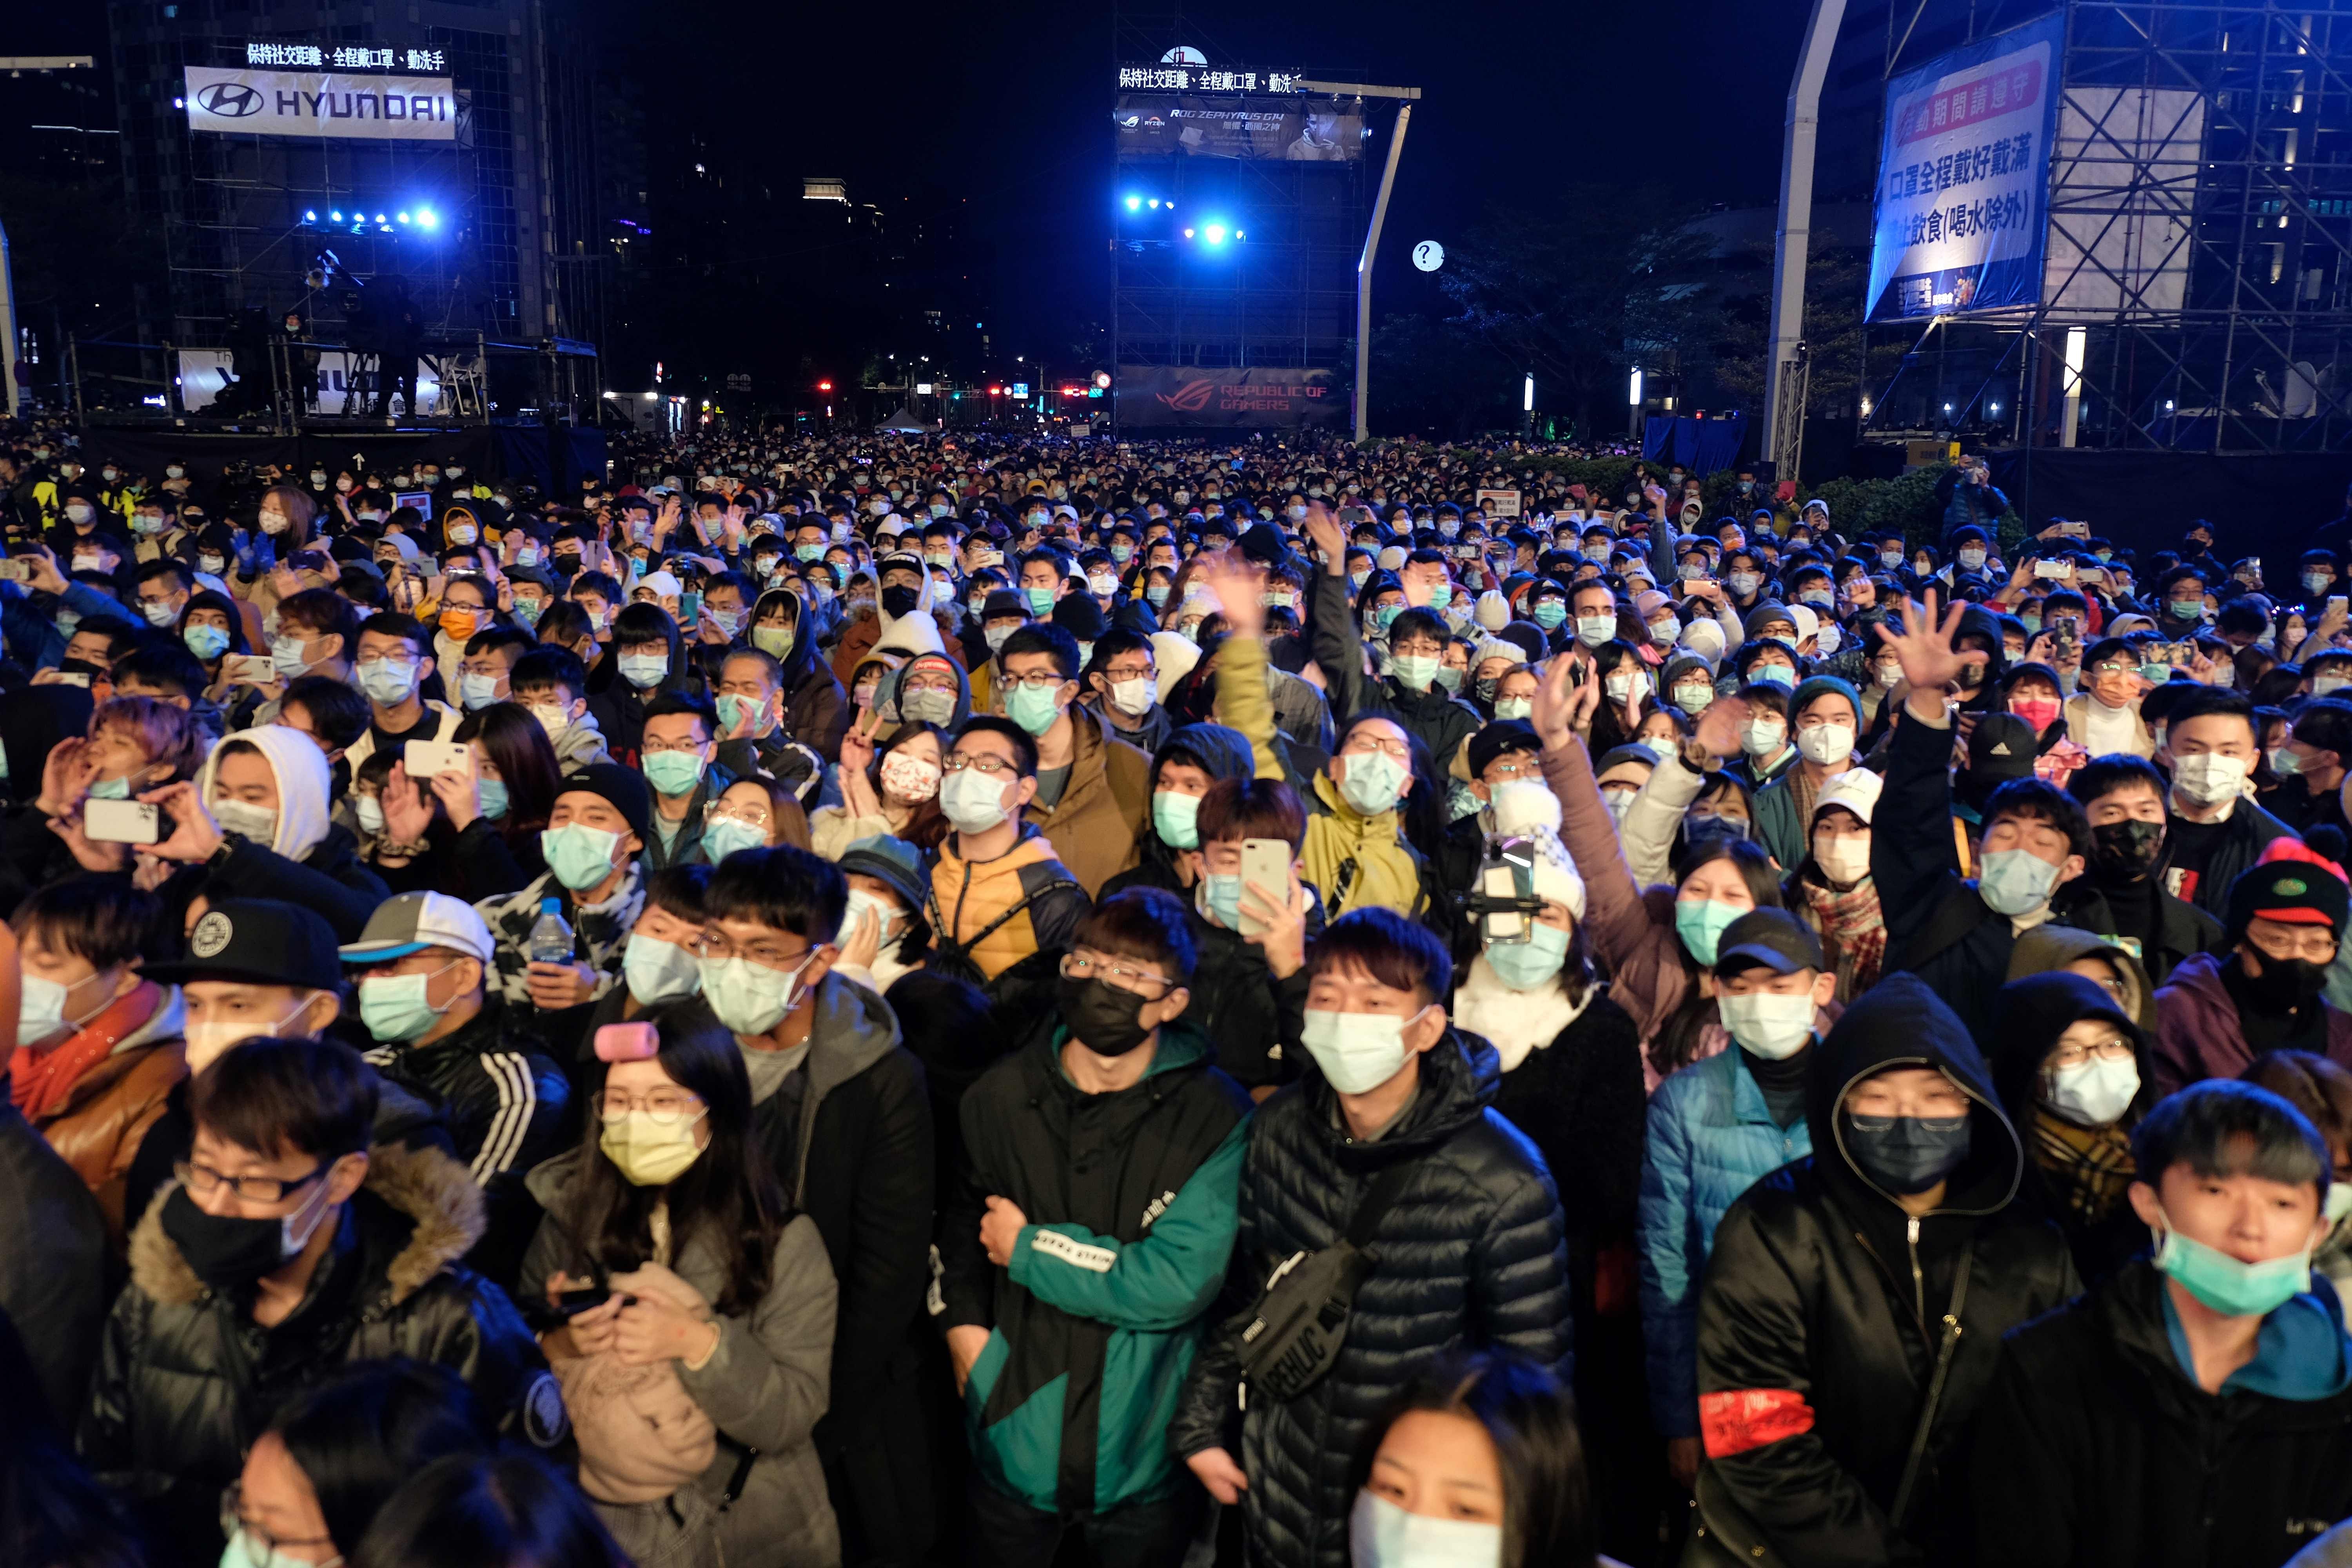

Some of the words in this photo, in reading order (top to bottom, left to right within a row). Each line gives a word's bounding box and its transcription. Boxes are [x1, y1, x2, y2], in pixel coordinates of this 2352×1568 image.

[247, 44, 445, 71] 保持社交距離、全程戴口罩、勤洗手
[277, 91, 445, 121] HYUNDAI
[1198, 111, 1261, 120] ZEPHYRUS
[1890, 132, 2032, 203] 口罩全程戴好戴滿
[1221, 385, 1302, 397] REPUBLIC
[1306, 387, 1327, 397] OF
[1221, 399, 1289, 411] GAMERS
